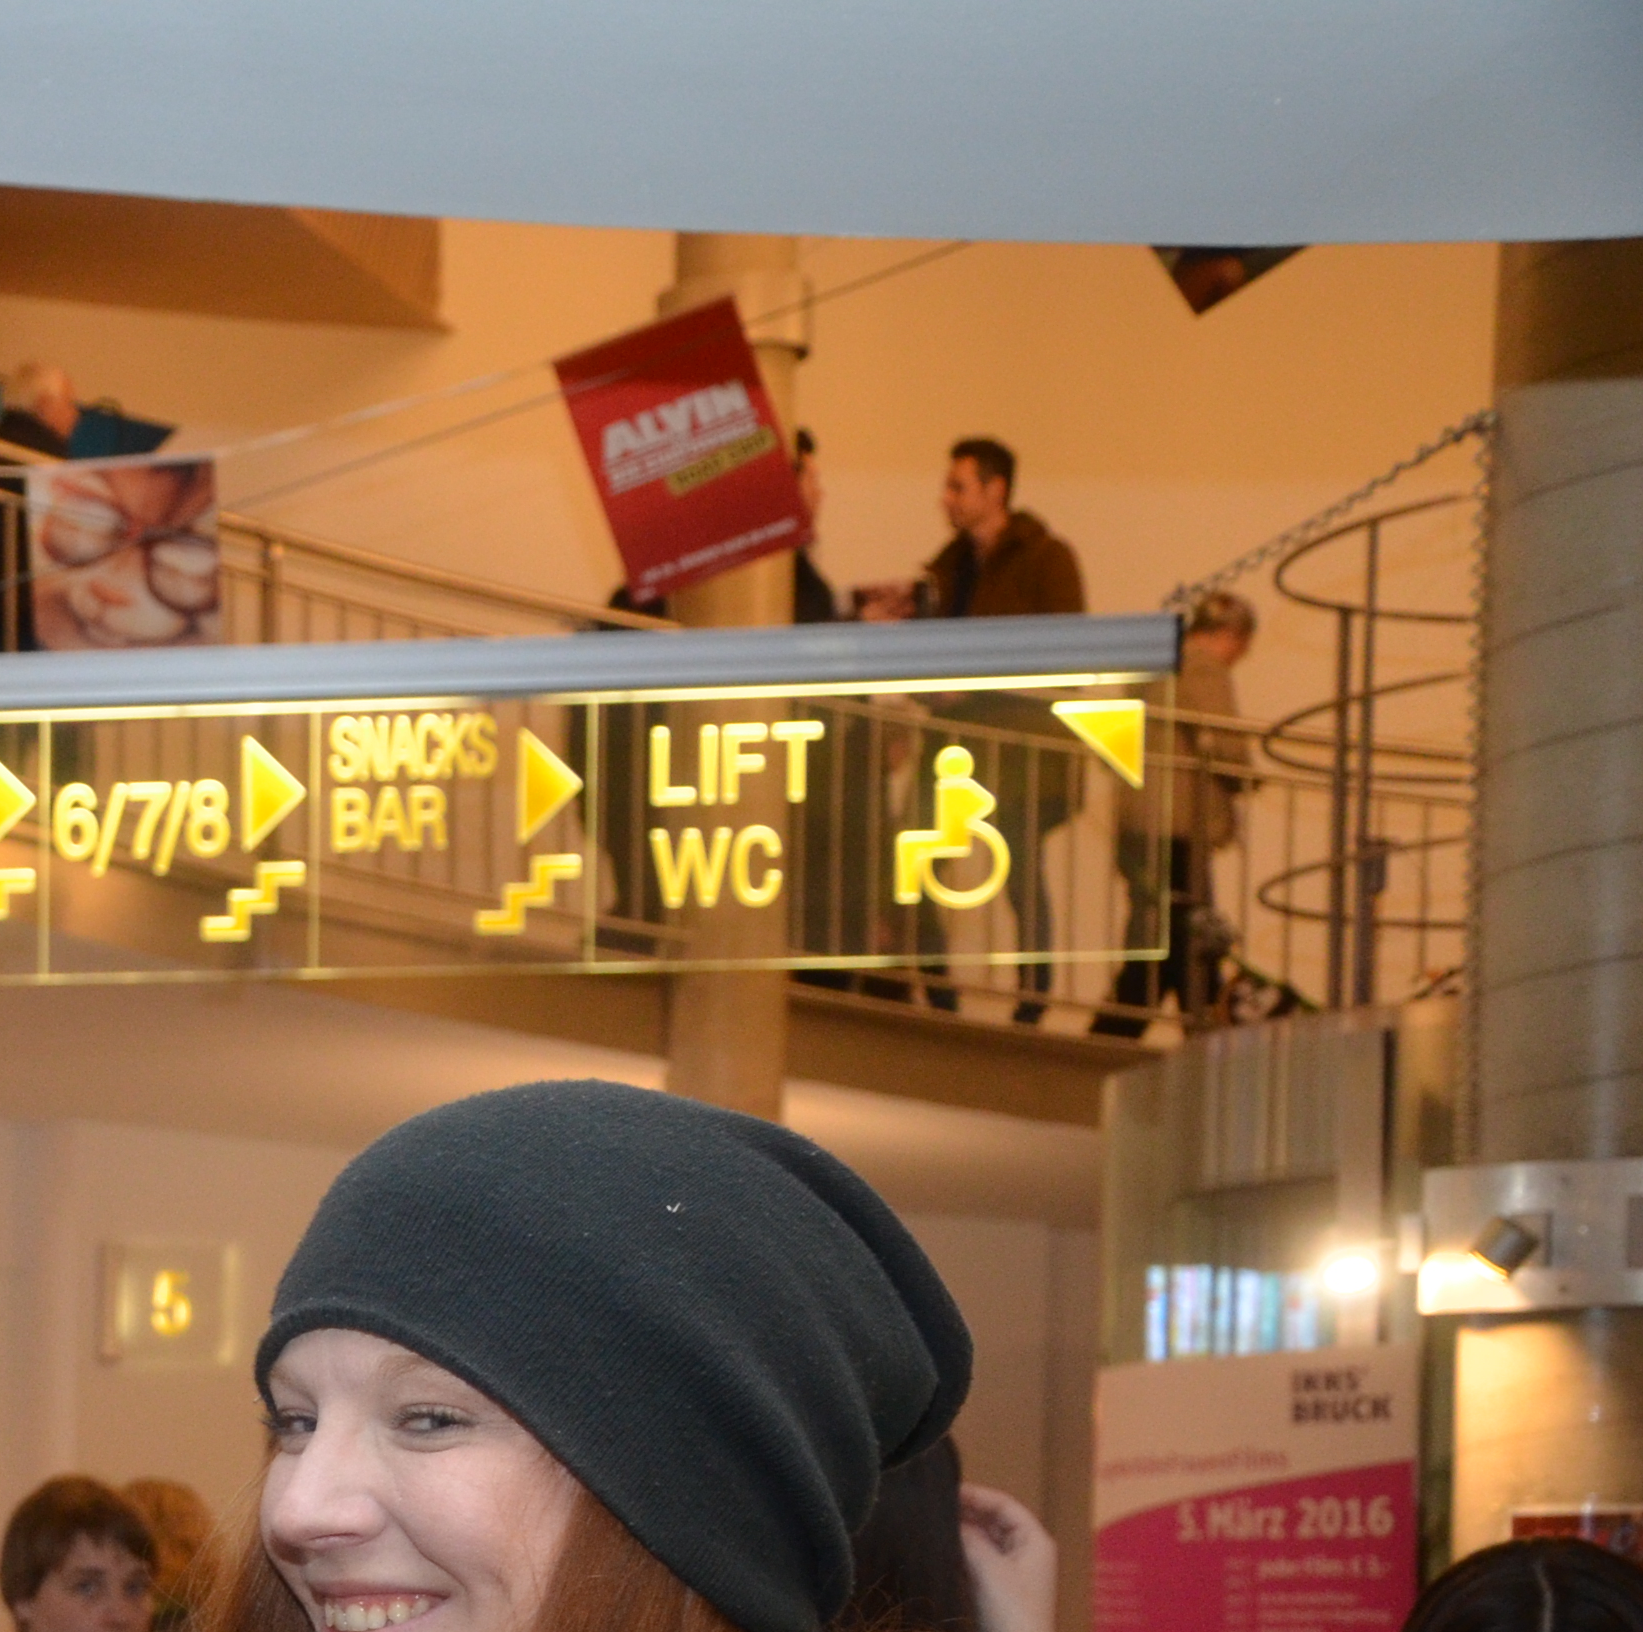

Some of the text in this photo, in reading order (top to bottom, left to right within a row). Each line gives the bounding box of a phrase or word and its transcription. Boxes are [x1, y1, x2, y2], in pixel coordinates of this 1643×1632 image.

[327, 712, 499, 784] SNACKS
[649, 720, 825, 806] LIFT
[53, 778, 231, 878] 6/7/8
[330, 784, 449, 854] BAR
[648, 825, 783, 909] WC
[1291, 1393, 1394, 1425] BRUCK
[1296, 1495, 1396, 1540] 2016
